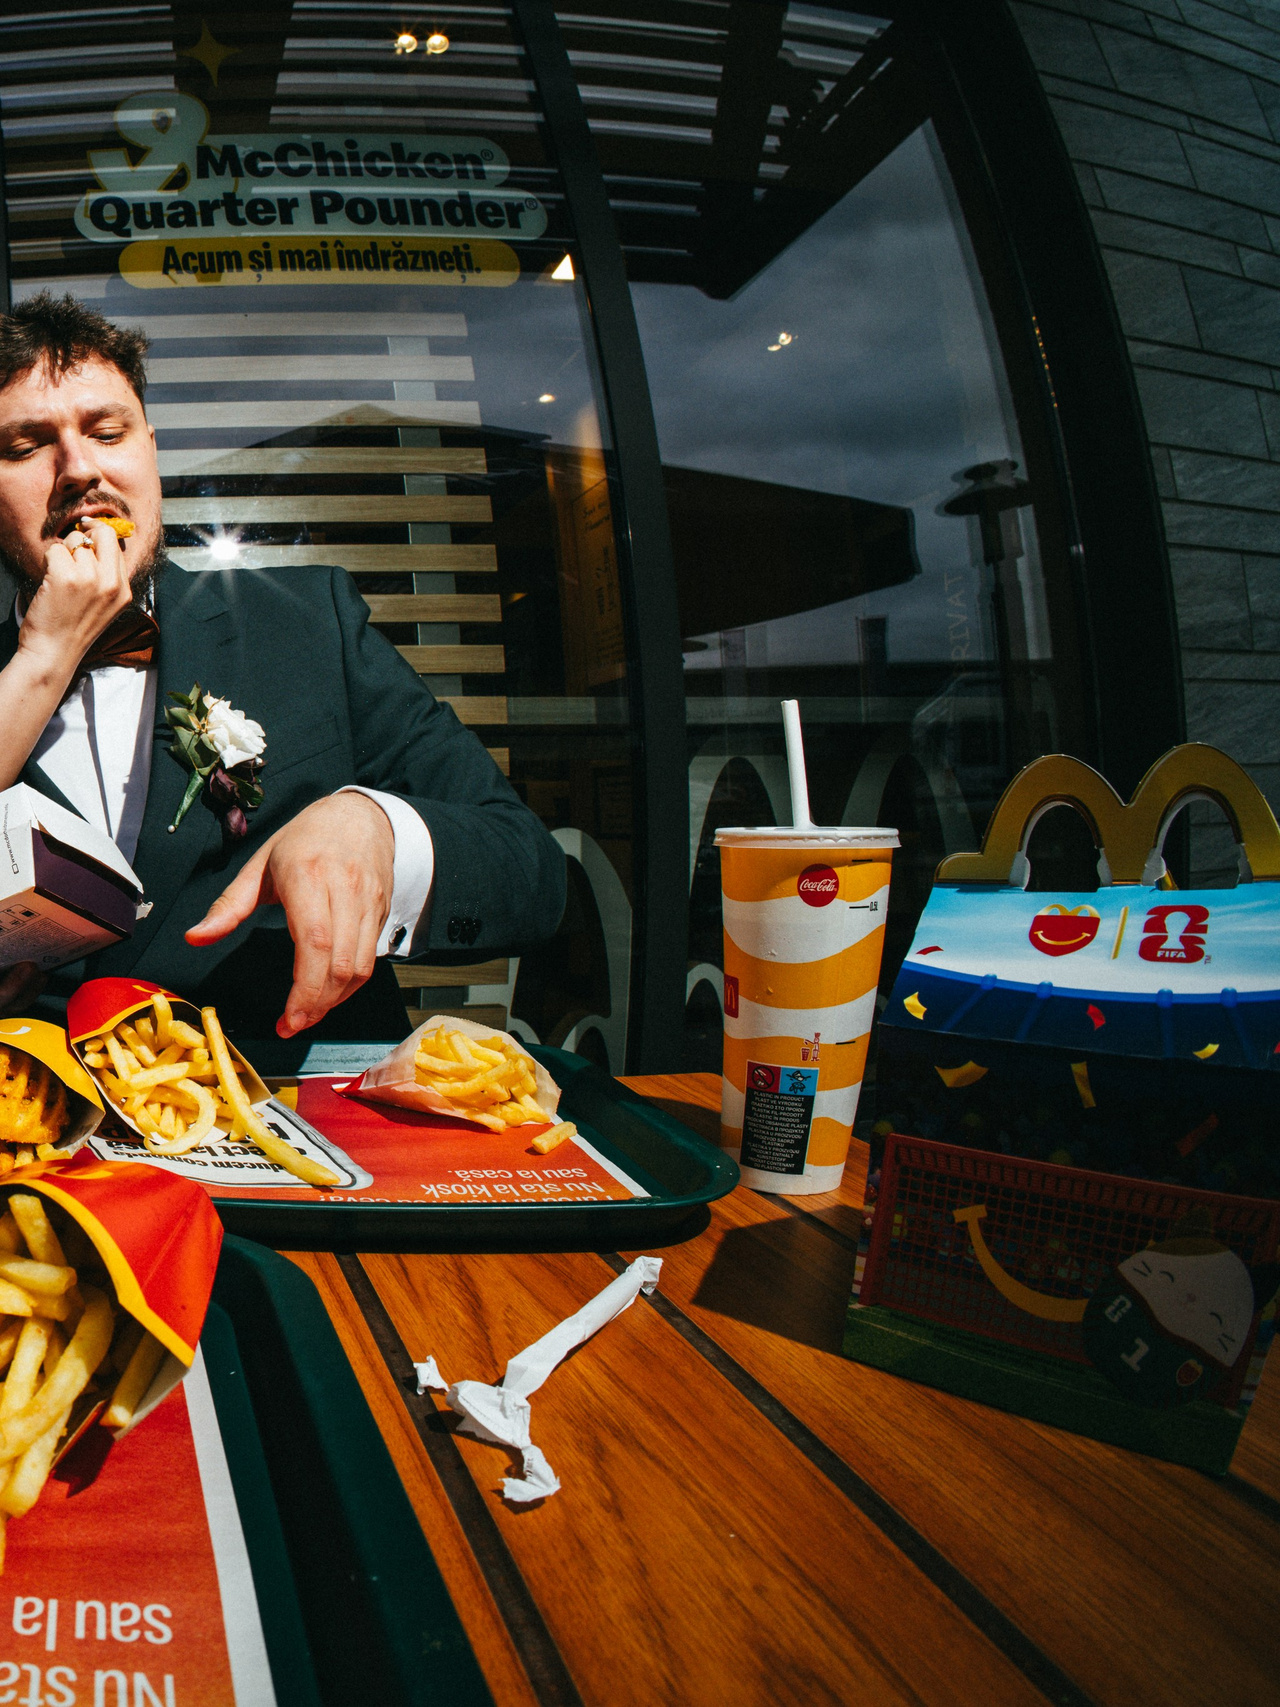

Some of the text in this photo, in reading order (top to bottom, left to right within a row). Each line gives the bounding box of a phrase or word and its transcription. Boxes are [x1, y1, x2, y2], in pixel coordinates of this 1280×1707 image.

[89, 191, 299, 238] Quarter
[161, 241, 482, 284] Acum și mai îndrăzneți.
[800, 878, 837, 892] Coca-Cola
[1157, 950, 1187, 958] FIFA
[754, 1111, 773, 1119] PLASTIC
[748, 1127, 769, 1135] PLASTIKA
[210, 1160, 289, 1172] ducem
[447, 1168, 588, 1183] sau la casă.
[420, 1181, 606, 1199] Nu sta la kiosk
[12, 1596, 59, 1652] la
[74, 1599, 174, 1644] sau
[93, 1669, 177, 1707] Nu
